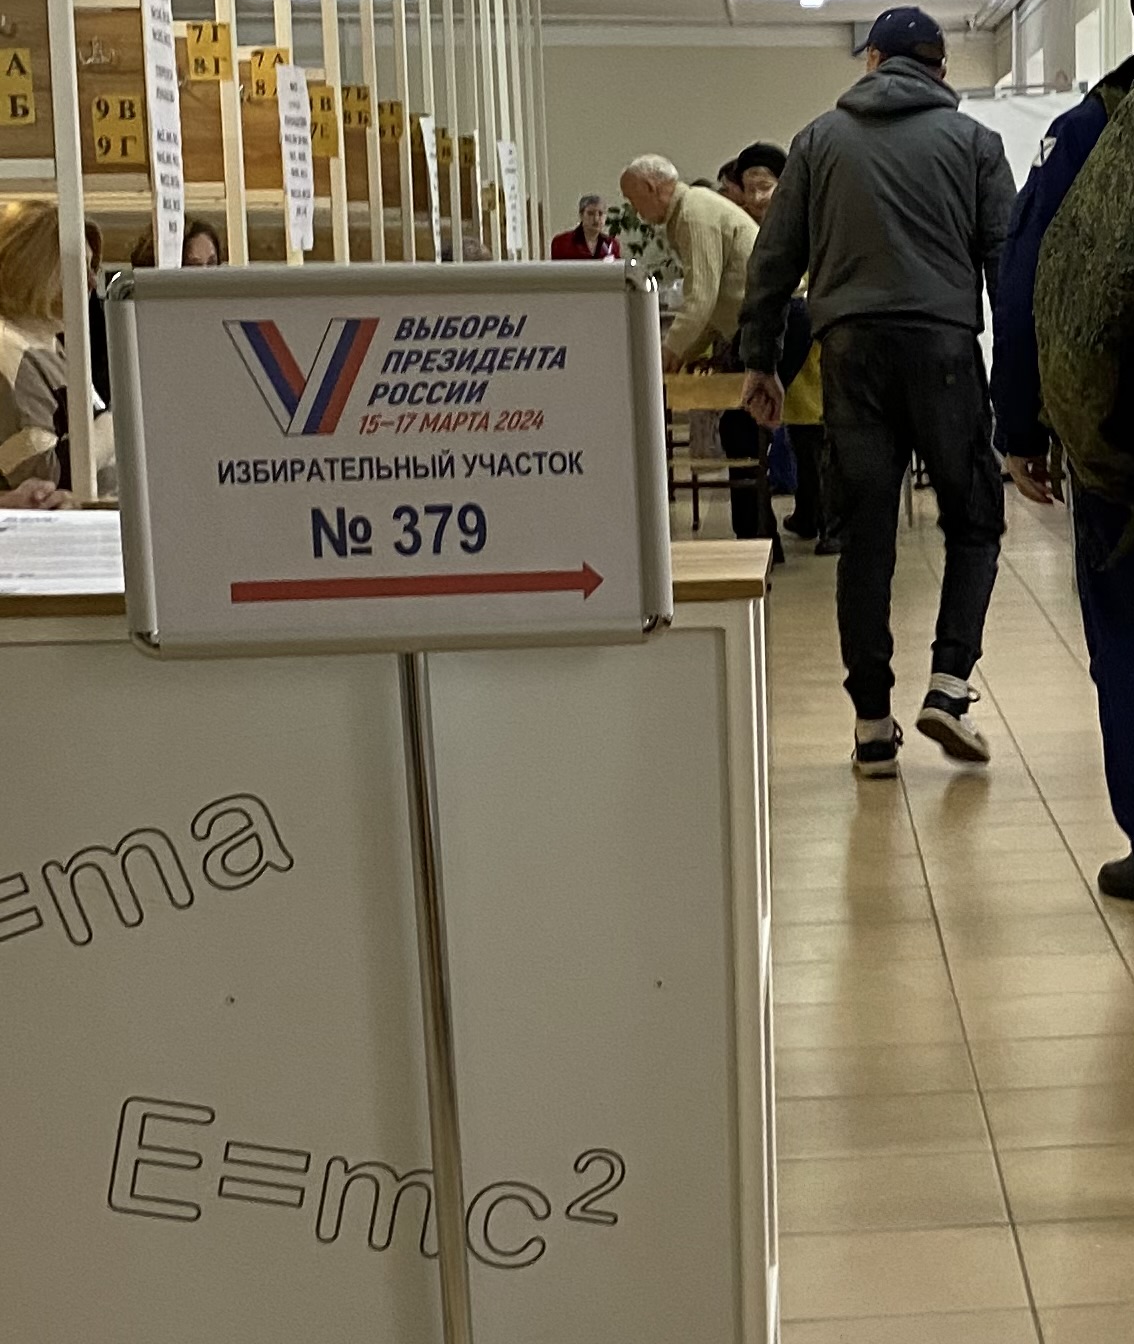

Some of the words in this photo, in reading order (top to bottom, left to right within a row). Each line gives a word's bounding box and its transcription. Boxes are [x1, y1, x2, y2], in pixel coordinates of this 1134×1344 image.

[393, 315, 526, 342] ВЫБОРЫ
[381, 345, 567, 374] ПРЕЗИДЕНТА
[368, 381, 487, 406] РОССИИ
[417, 411, 491, 433] МАРТА
[494, 410, 544, 431] 2024
[217, 448, 456, 486] ИЗБИРАТЕЛЬНЫЙ
[464, 450, 584, 478] УЧАСТОК
[312, 507, 373, 558] №
[393, 503, 487, 555] 379
